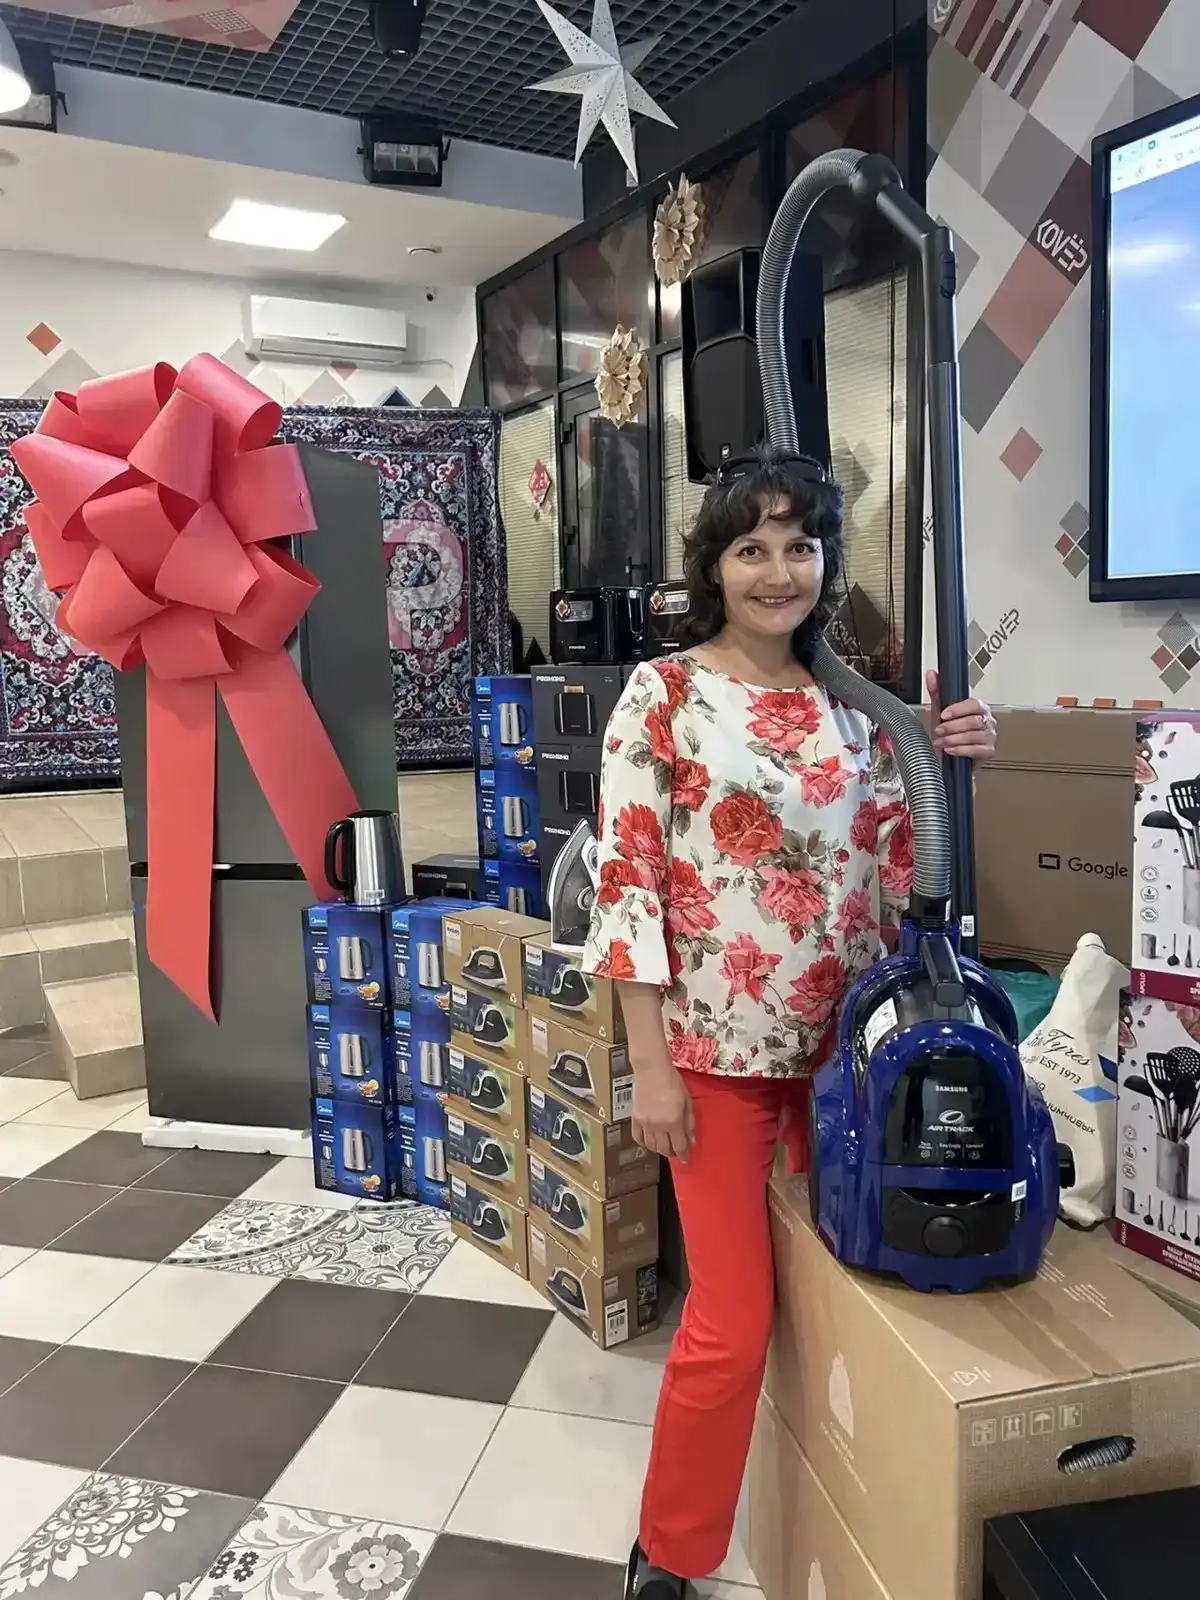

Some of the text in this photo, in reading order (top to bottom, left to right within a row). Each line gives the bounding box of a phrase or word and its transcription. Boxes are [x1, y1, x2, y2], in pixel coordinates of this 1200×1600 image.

[1068, 856, 1128, 879] Google
[1043, 1028, 1090, 1065] Tyres
[1040, 1056, 1059, 1071] EST
[1059, 1067, 1082, 1084] 1973
